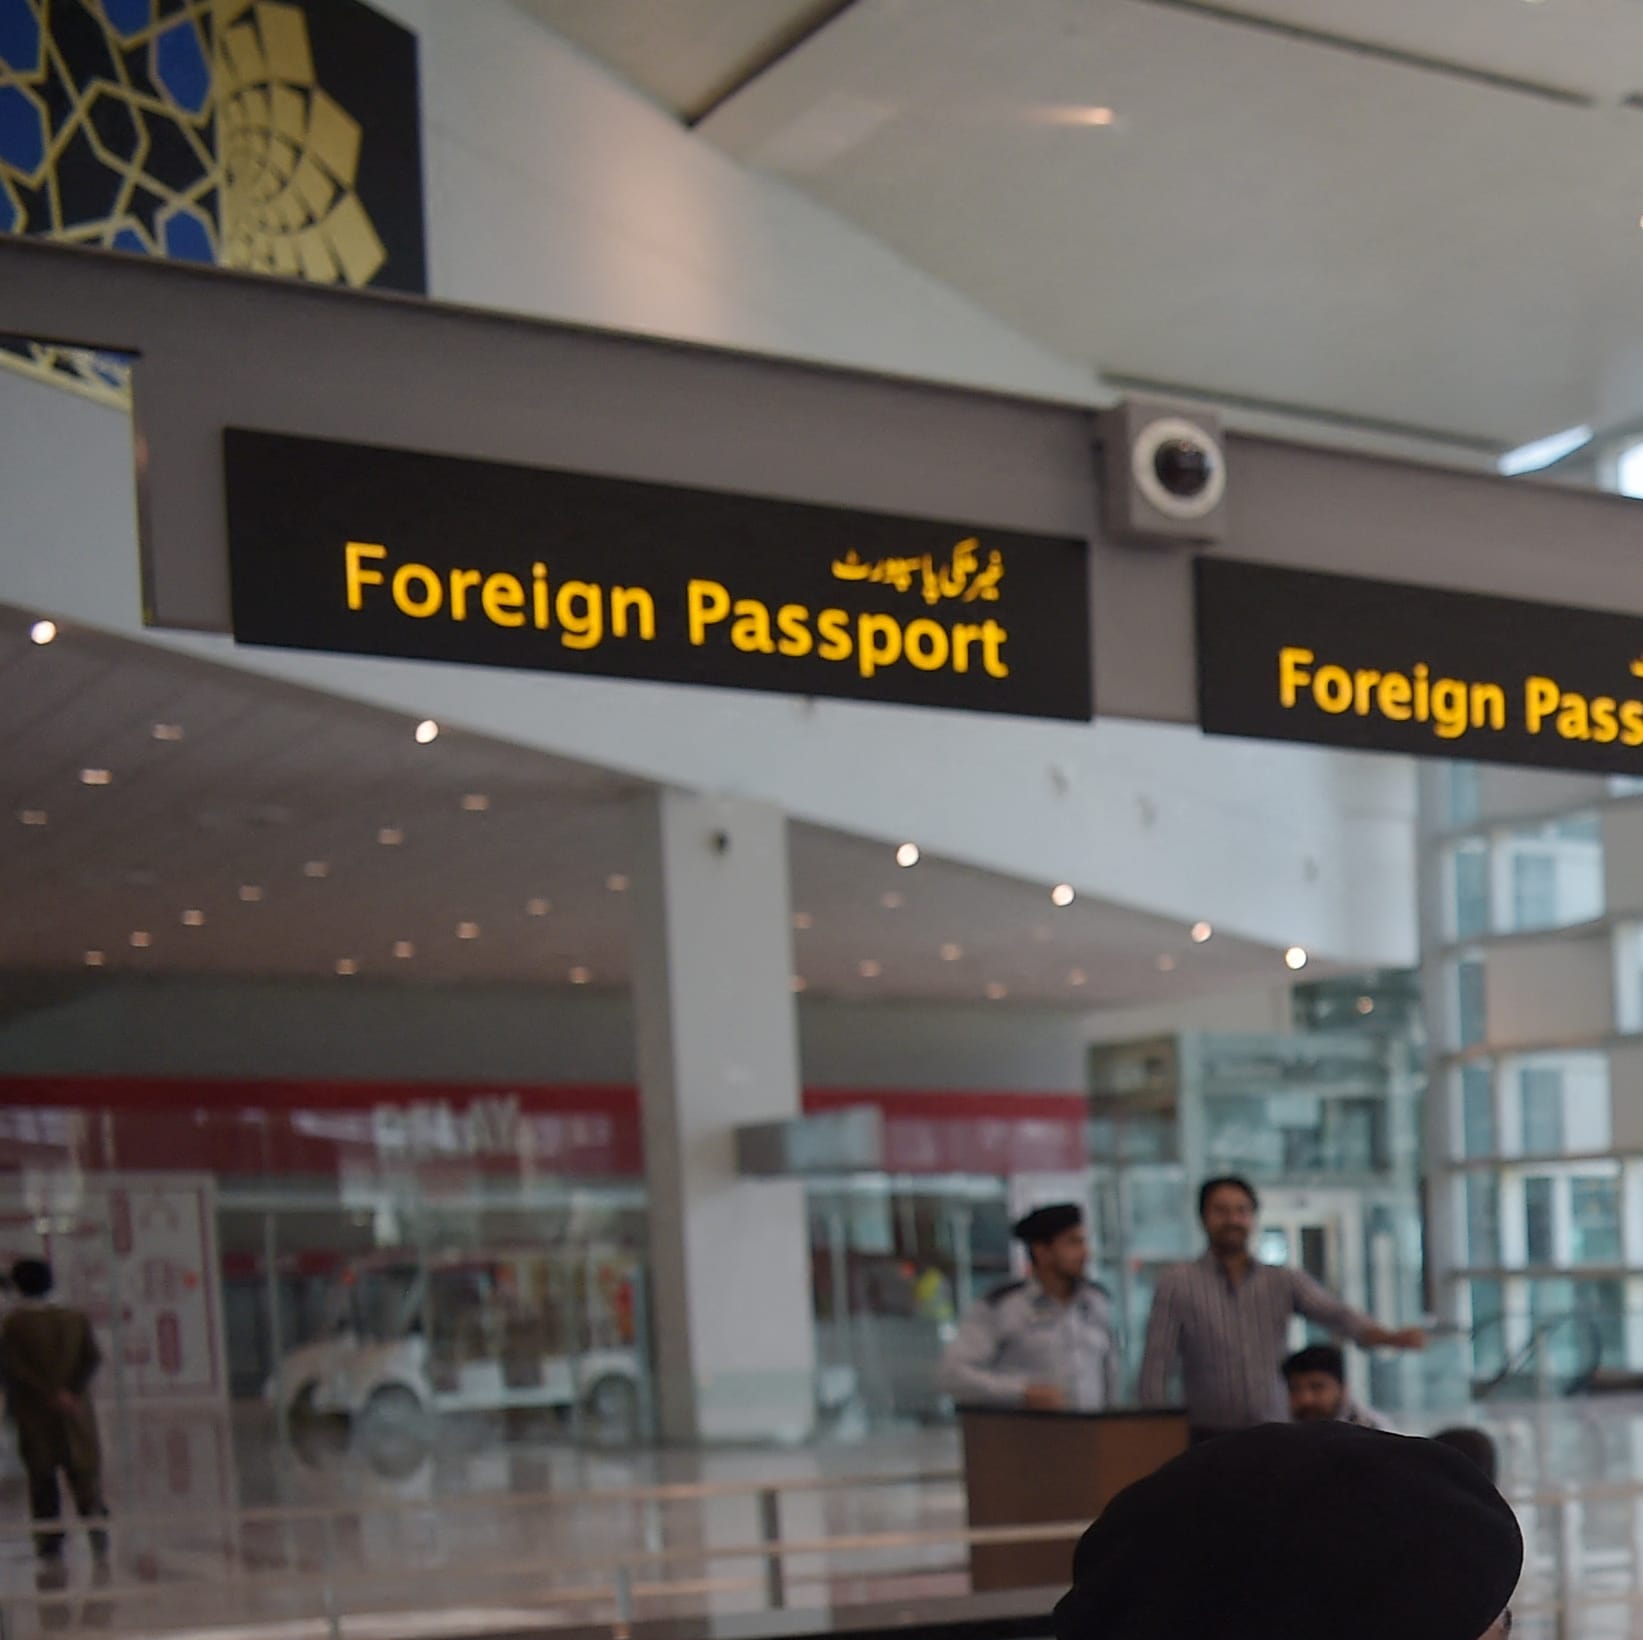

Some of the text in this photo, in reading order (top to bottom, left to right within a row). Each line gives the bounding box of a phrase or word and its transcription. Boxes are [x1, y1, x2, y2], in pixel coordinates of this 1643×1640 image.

[344, 540, 1010, 679] Foreign Passport
[1278, 645, 1506, 740] Foreign
